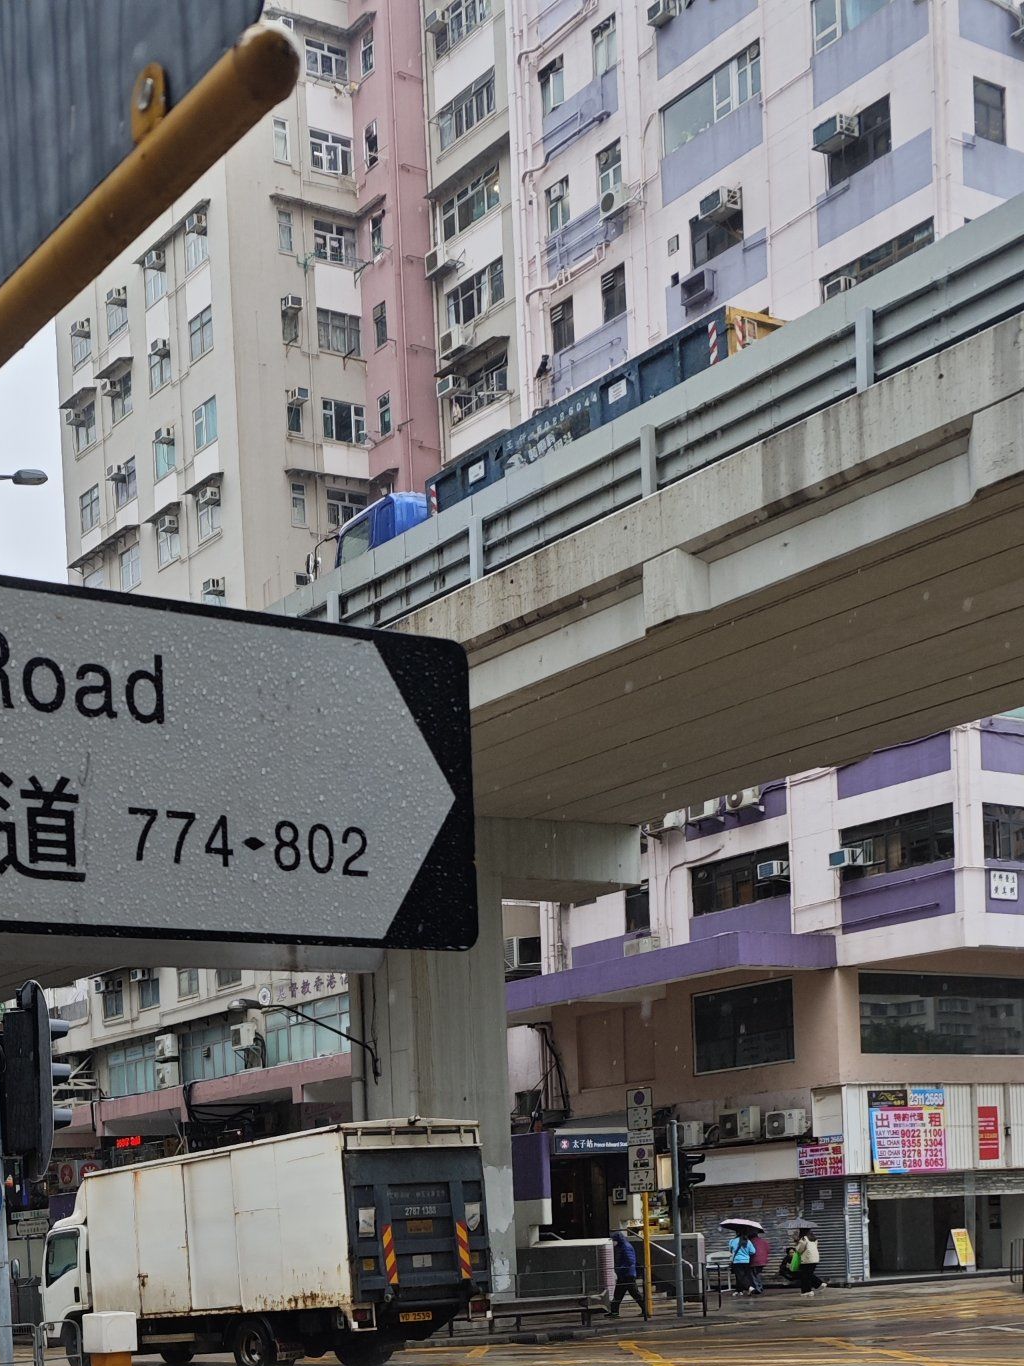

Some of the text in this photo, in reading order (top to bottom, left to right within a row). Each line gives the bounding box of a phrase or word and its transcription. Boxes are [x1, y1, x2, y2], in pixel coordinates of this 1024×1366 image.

[876, 1113, 890, 1128] 出
[928, 1112, 942, 1127] 租
[900, 1129, 921, 1138] 9022
[923, 1129, 942, 1138] 1100
[572, 1139, 594, 1149] 太子站
[901, 1139, 922, 1148] 9355
[923, 1138, 943, 1148] 3304
[901, 1149, 922, 1158] 9278
[925, 1148, 943, 1158] 7321
